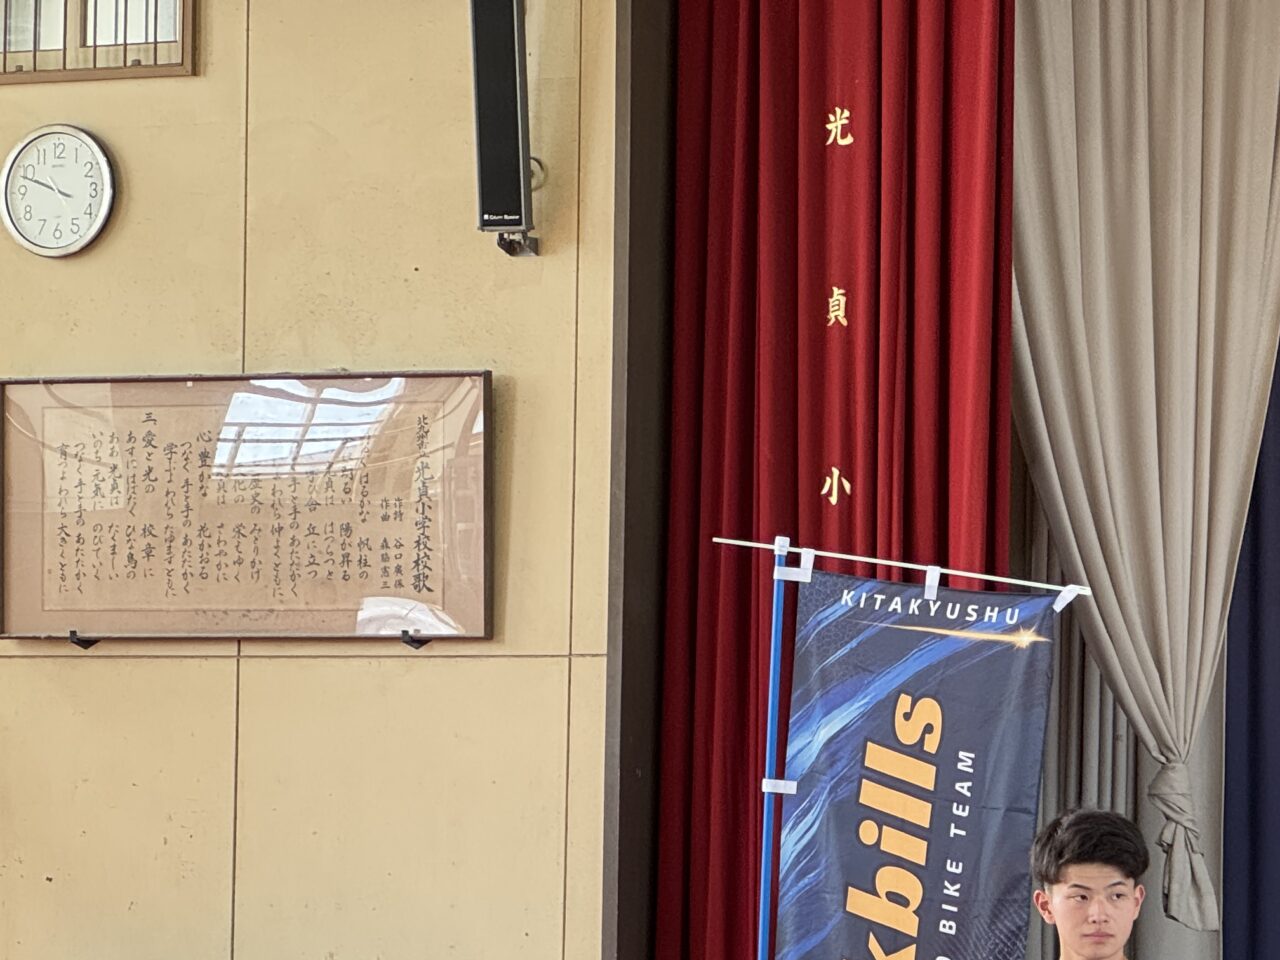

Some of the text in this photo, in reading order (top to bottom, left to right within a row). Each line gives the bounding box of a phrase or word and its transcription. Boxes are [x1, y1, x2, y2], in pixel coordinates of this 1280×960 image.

[36, 145, 46, 165] 11
[53, 142, 66, 159] 12
[74, 147, 78, 164] 1
[22, 164, 35, 180] 10
[83, 161, 94, 178] 2
[18, 184, 27, 200] 9
[89, 182, 98, 199] 3
[23, 204, 32, 221] 8
[83, 203, 93, 219] 4
[38, 219, 47, 235] 7
[53, 223, 62, 240] 6
[70, 218, 80, 234] 5
[841, 589, 1020, 625] KITAKYUSHU
[950, 750, 976, 838] TEAM
[938, 859, 963, 936] BIKE
